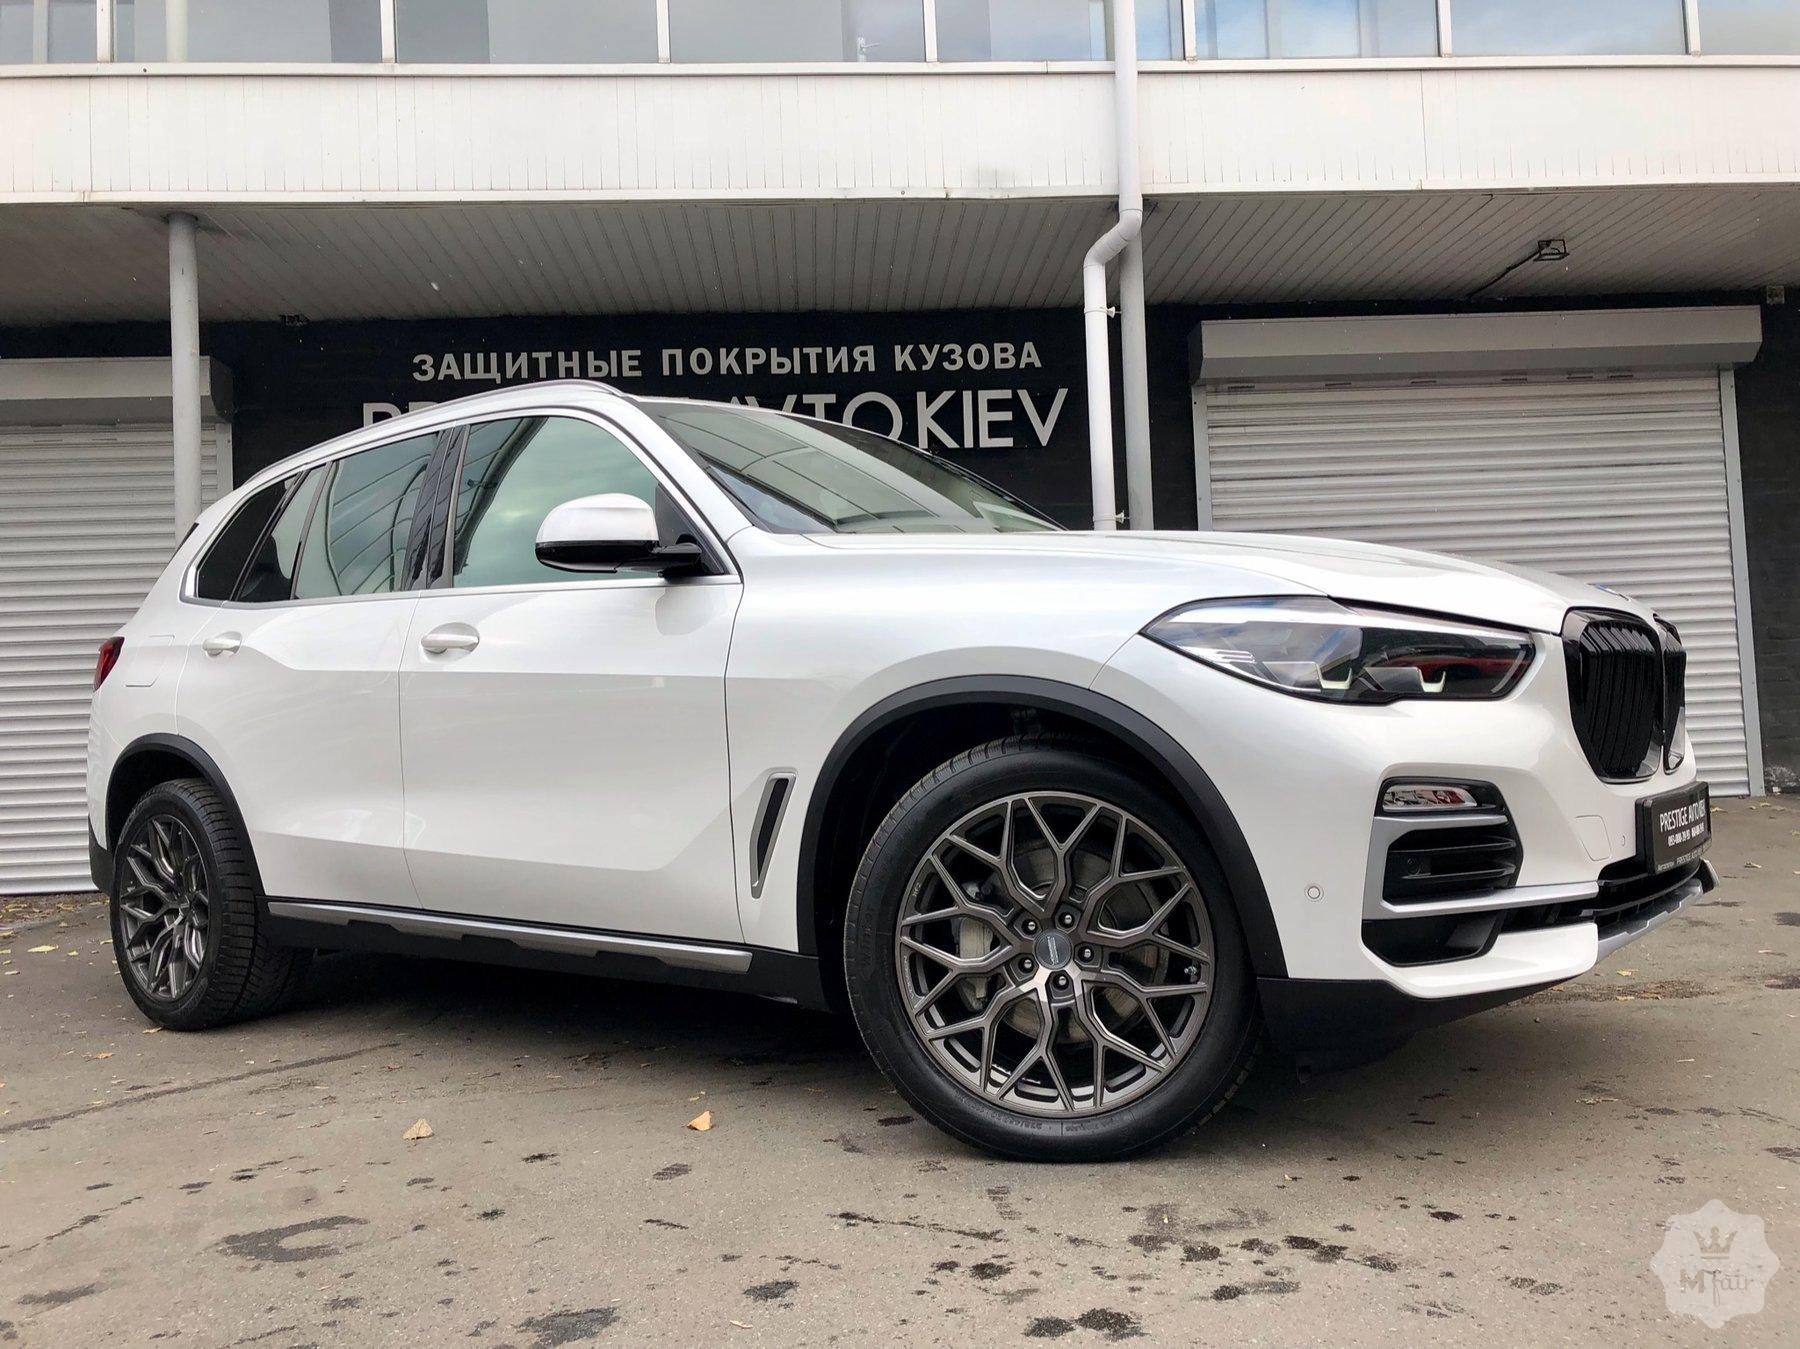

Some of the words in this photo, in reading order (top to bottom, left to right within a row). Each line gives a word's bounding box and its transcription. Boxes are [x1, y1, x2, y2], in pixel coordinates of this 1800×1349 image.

[412, 350, 642, 384] ЗАЩИТНЫЕ
[661, 345, 876, 376] ПОКРЫТИЯ
[894, 342, 1042, 372] КУЗОВА
[1660, 806, 1689, 832] PRESTIGE
